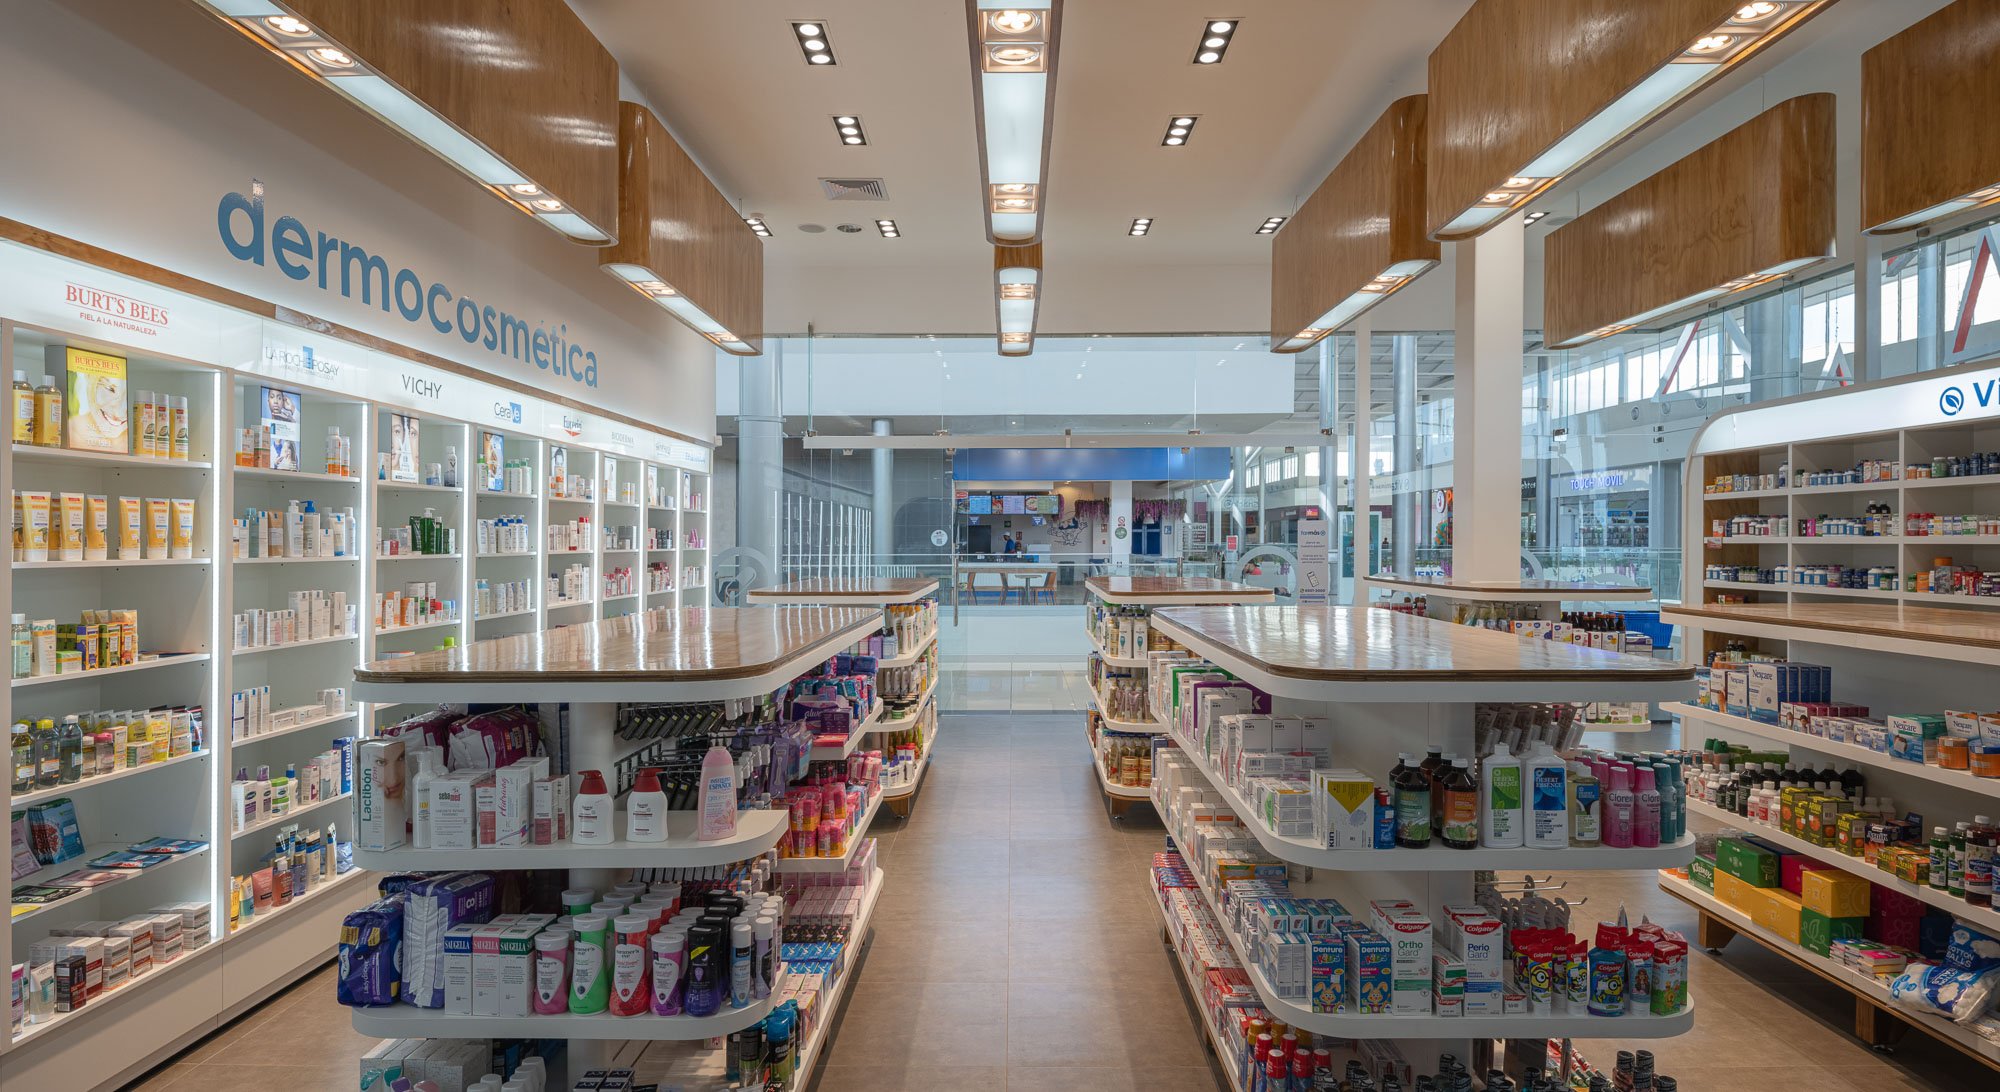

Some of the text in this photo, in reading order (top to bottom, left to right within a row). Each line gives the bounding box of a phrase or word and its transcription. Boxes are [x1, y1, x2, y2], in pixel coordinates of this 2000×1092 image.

[217, 177, 599, 388] dermocosmética
[66, 284, 169, 325] BURT'S BEES
[80, 312, 157, 336] FIEL A LA NATURALEZA
[402, 374, 442, 399] VICHY
[1570, 475, 1623, 490] TOUCH MOVIL
[1752, 668, 1773, 681] Nexcare
[1893, 721, 1917, 733] Nexcare
[1953, 721, 1974, 731] Nexcare
[361, 768, 372, 822] Lactibón
[1691, 862, 1713, 880] Kleenex
[1397, 924, 1425, 932] Colgate
[445, 940, 470, 950] SAUGELLA
[473, 941, 499, 950] SAUGELLA
[500, 942, 526, 952] SAUGELLA
[1398, 940, 1423, 949] Ortho
[1467, 943, 1489, 952] Perio
[1398, 948, 1419, 957] Gard
[1467, 950, 1488, 960] Gard
[1629, 951, 1653, 959] Colgate
[1948, 944, 1975, 961] COTTON
[1945, 951, 1972, 968] BALLS
[1599, 965, 1622, 973] Colgate
